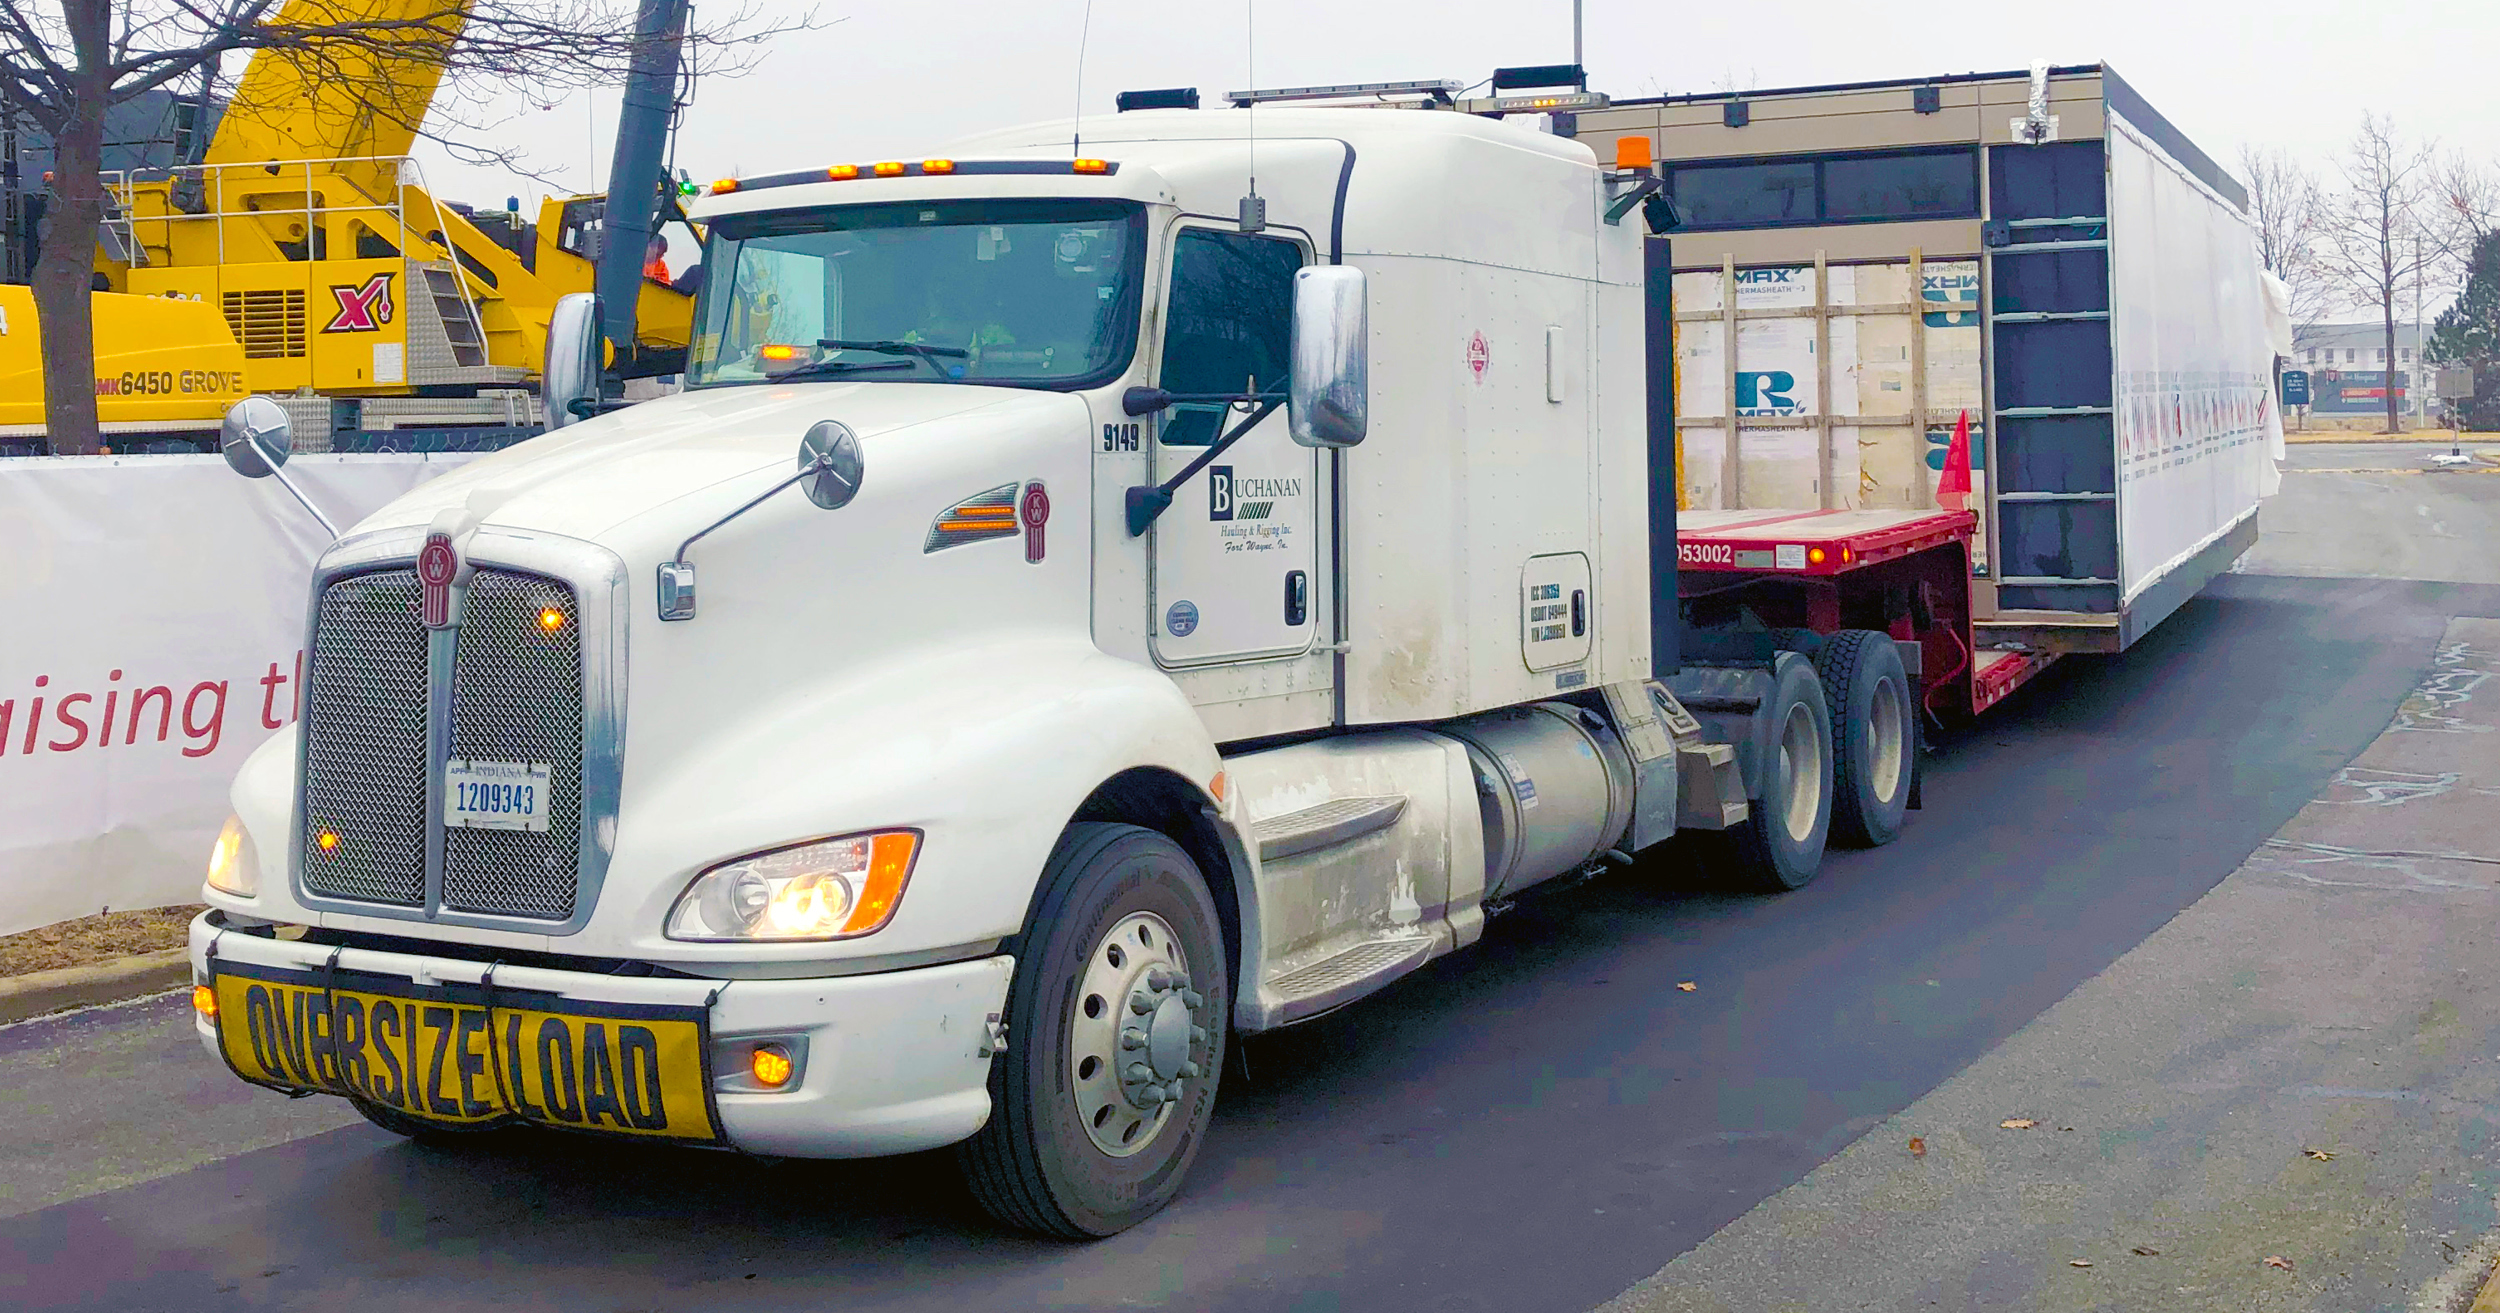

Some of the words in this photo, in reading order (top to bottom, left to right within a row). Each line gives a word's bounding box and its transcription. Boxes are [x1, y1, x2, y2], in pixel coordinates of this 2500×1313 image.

[1734, 270, 1790, 283] MAX
[180, 370, 243, 393] GROVE
[1735, 371, 1794, 407] R
[1103, 423, 1139, 451] 9149
[1213, 474, 1301, 512] BUCHANAN
[1221, 525, 1248, 539] Hauling
[1249, 526, 1255, 536] &
[1256, 523, 1280, 538] Rigging
[1281, 523, 1293, 535] Inc.
[1225, 541, 1243, 554] Fort
[475, 766, 522, 778] INDIANA
[457, 782, 534, 815] 1209343
[245, 984, 493, 1118] OVERSIZE
[507, 1013, 669, 1130] LOAD
